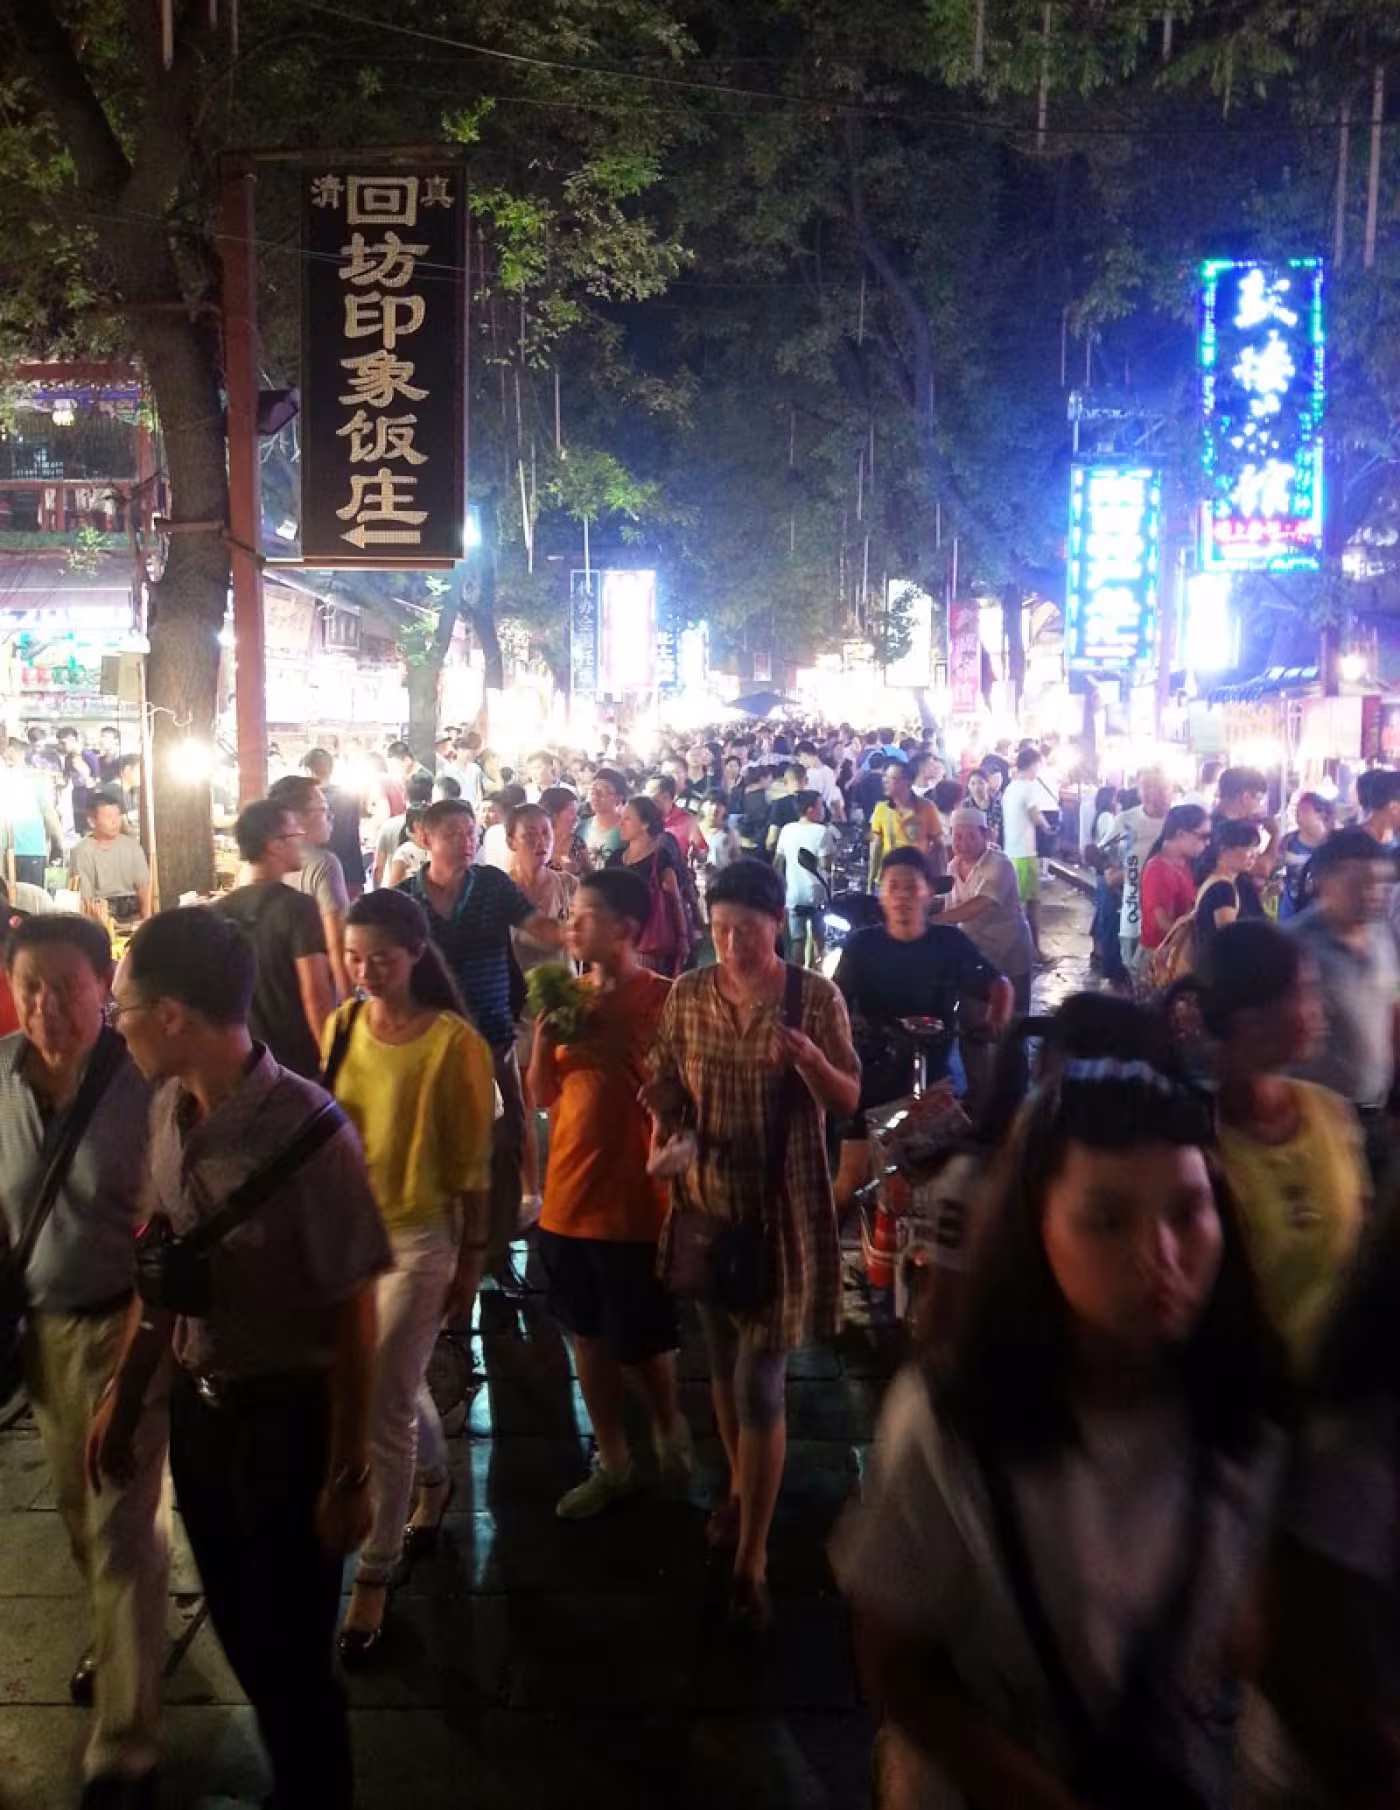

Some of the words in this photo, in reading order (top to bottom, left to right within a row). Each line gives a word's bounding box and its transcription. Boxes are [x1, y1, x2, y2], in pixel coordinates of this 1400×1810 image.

[310, 174, 345, 209] 清
[420, 174, 455, 208] 真
[336, 175, 431, 525] 回坊印象饭庄
